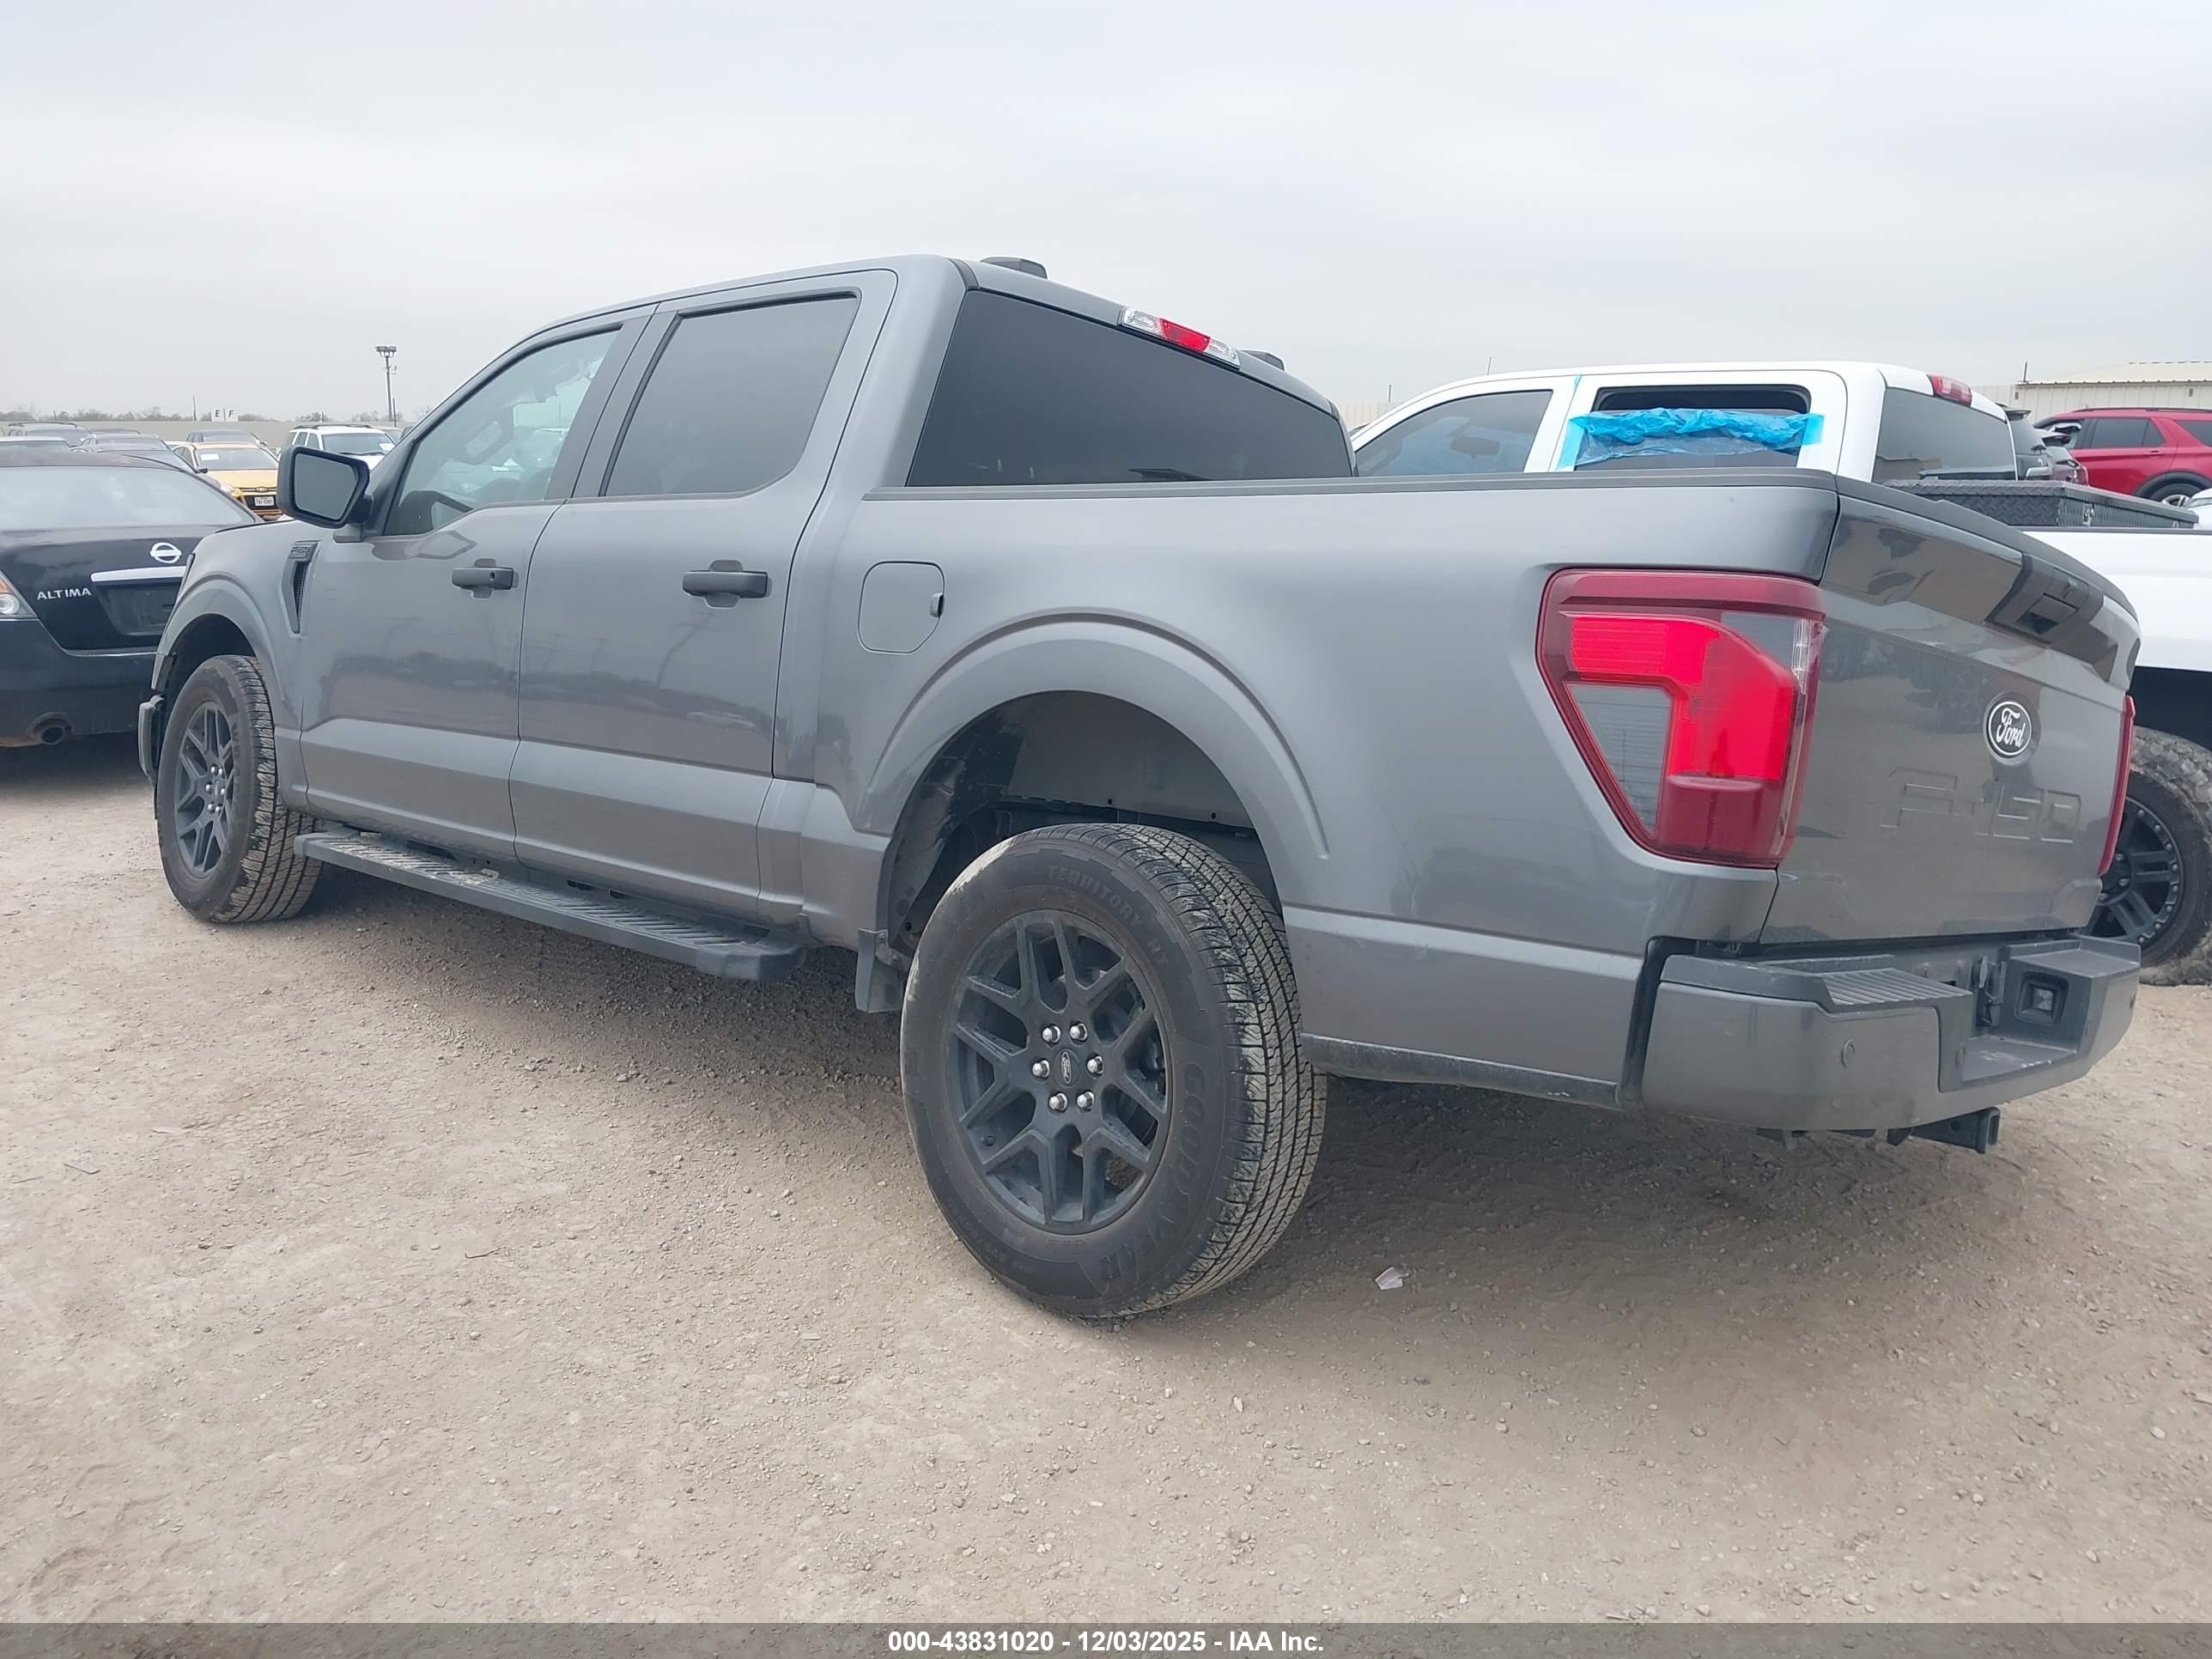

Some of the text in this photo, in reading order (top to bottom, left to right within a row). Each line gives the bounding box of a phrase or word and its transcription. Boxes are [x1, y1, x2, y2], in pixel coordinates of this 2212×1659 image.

[215, 409, 221, 418] E
[37, 587, 92, 600] ALTIMA
[1996, 707, 2027, 748] Ford
[1879, 767, 2082, 843] F-150
[1048, 865, 1143, 927] TERRITORY
